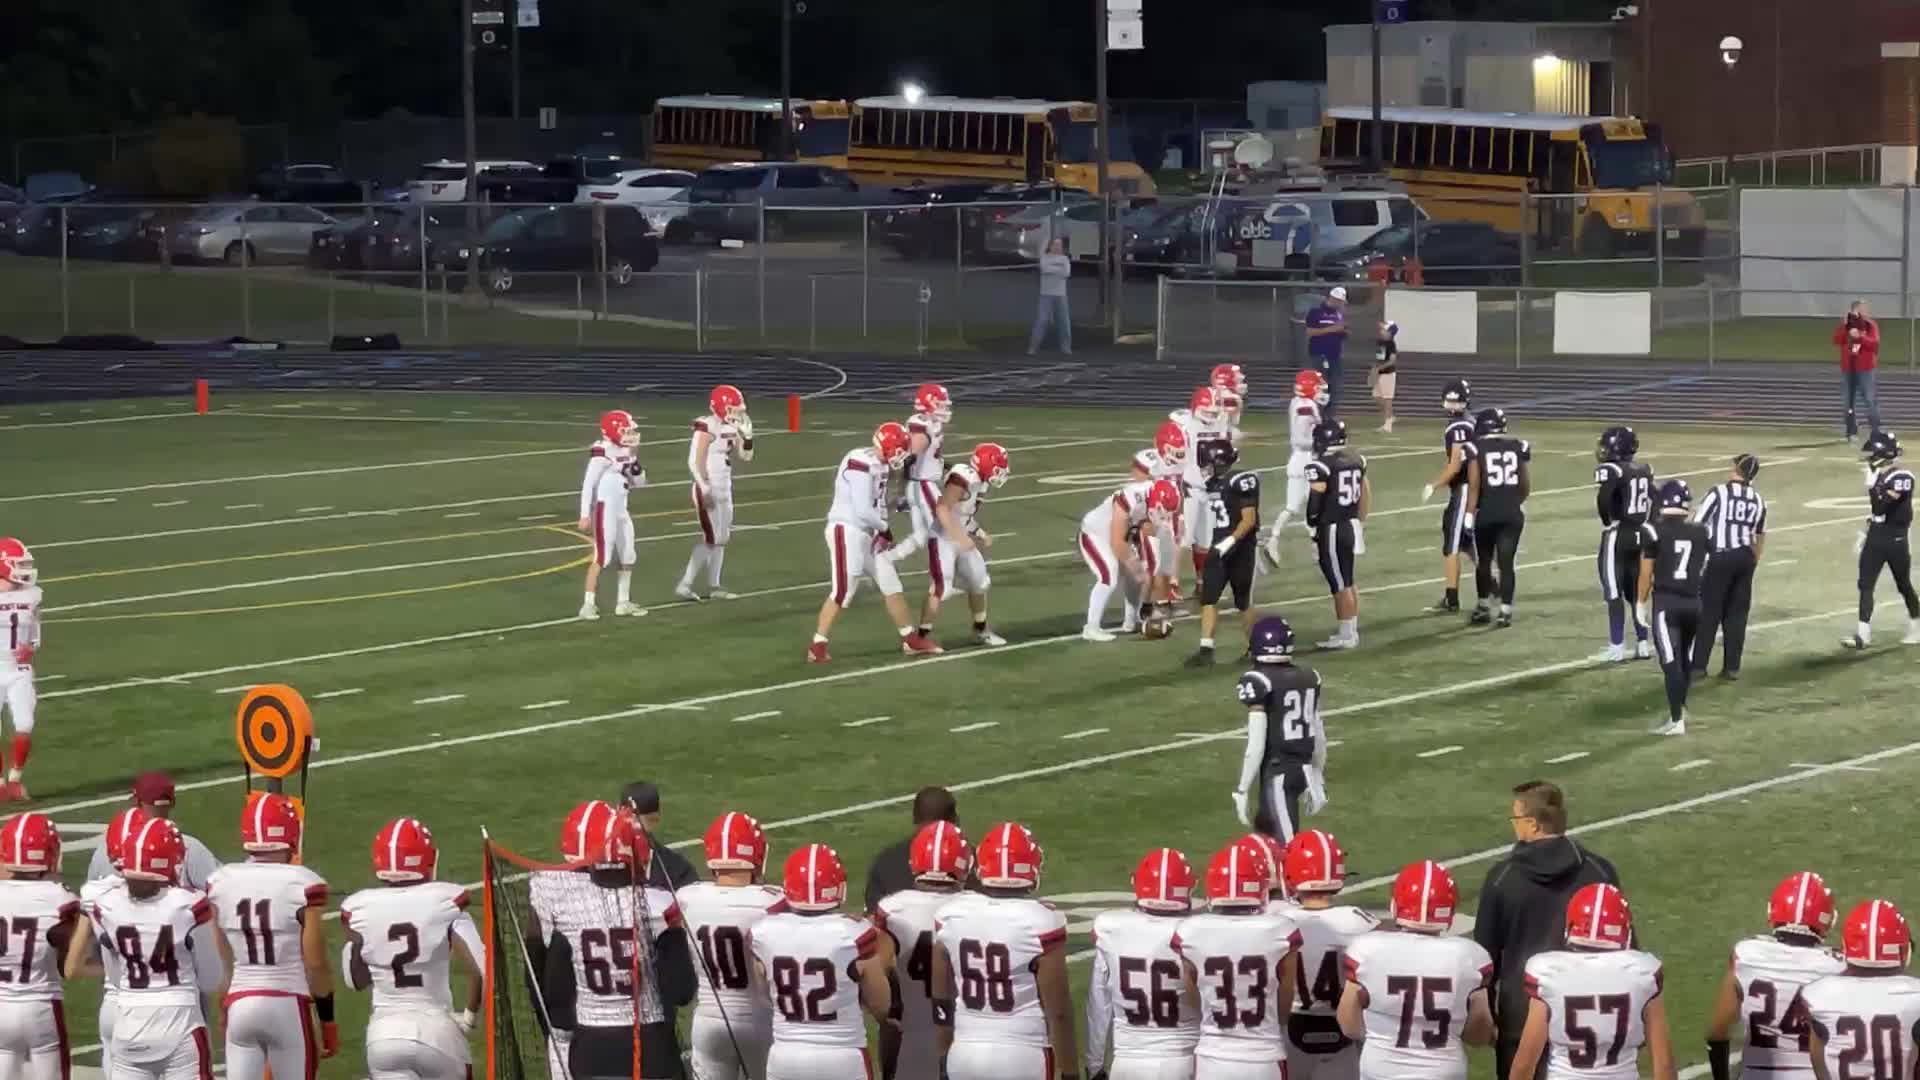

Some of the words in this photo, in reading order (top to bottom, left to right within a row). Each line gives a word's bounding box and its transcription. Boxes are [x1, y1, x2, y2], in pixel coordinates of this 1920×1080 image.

[1240, 477, 1257, 492] 53
[1486, 451, 1519, 487] 52
[1627, 477, 1649, 515] 12
[1727, 499, 1758, 523] 187
[1673, 540, 1693, 580] 7
[1236, 682, 1257, 699] 24
[1283, 688, 1317, 741] 24
[115, 924, 180, 989] 84
[236, 898, 276, 965] 11
[388, 922, 424, 988] 2
[578, 927, 635, 996] 65
[697, 925, 748, 990] 10
[773, 956, 837, 1021] 82
[960, 938, 1015, 1012] 68
[1119, 956, 1180, 1028] 56
[1204, 955, 1269, 1029] 33
[1387, 975, 1452, 1050] 75
[1564, 993, 1631, 1069] 57
[1749, 979, 1812, 1051] 24
[1836, 1013, 1901, 1080] 20
